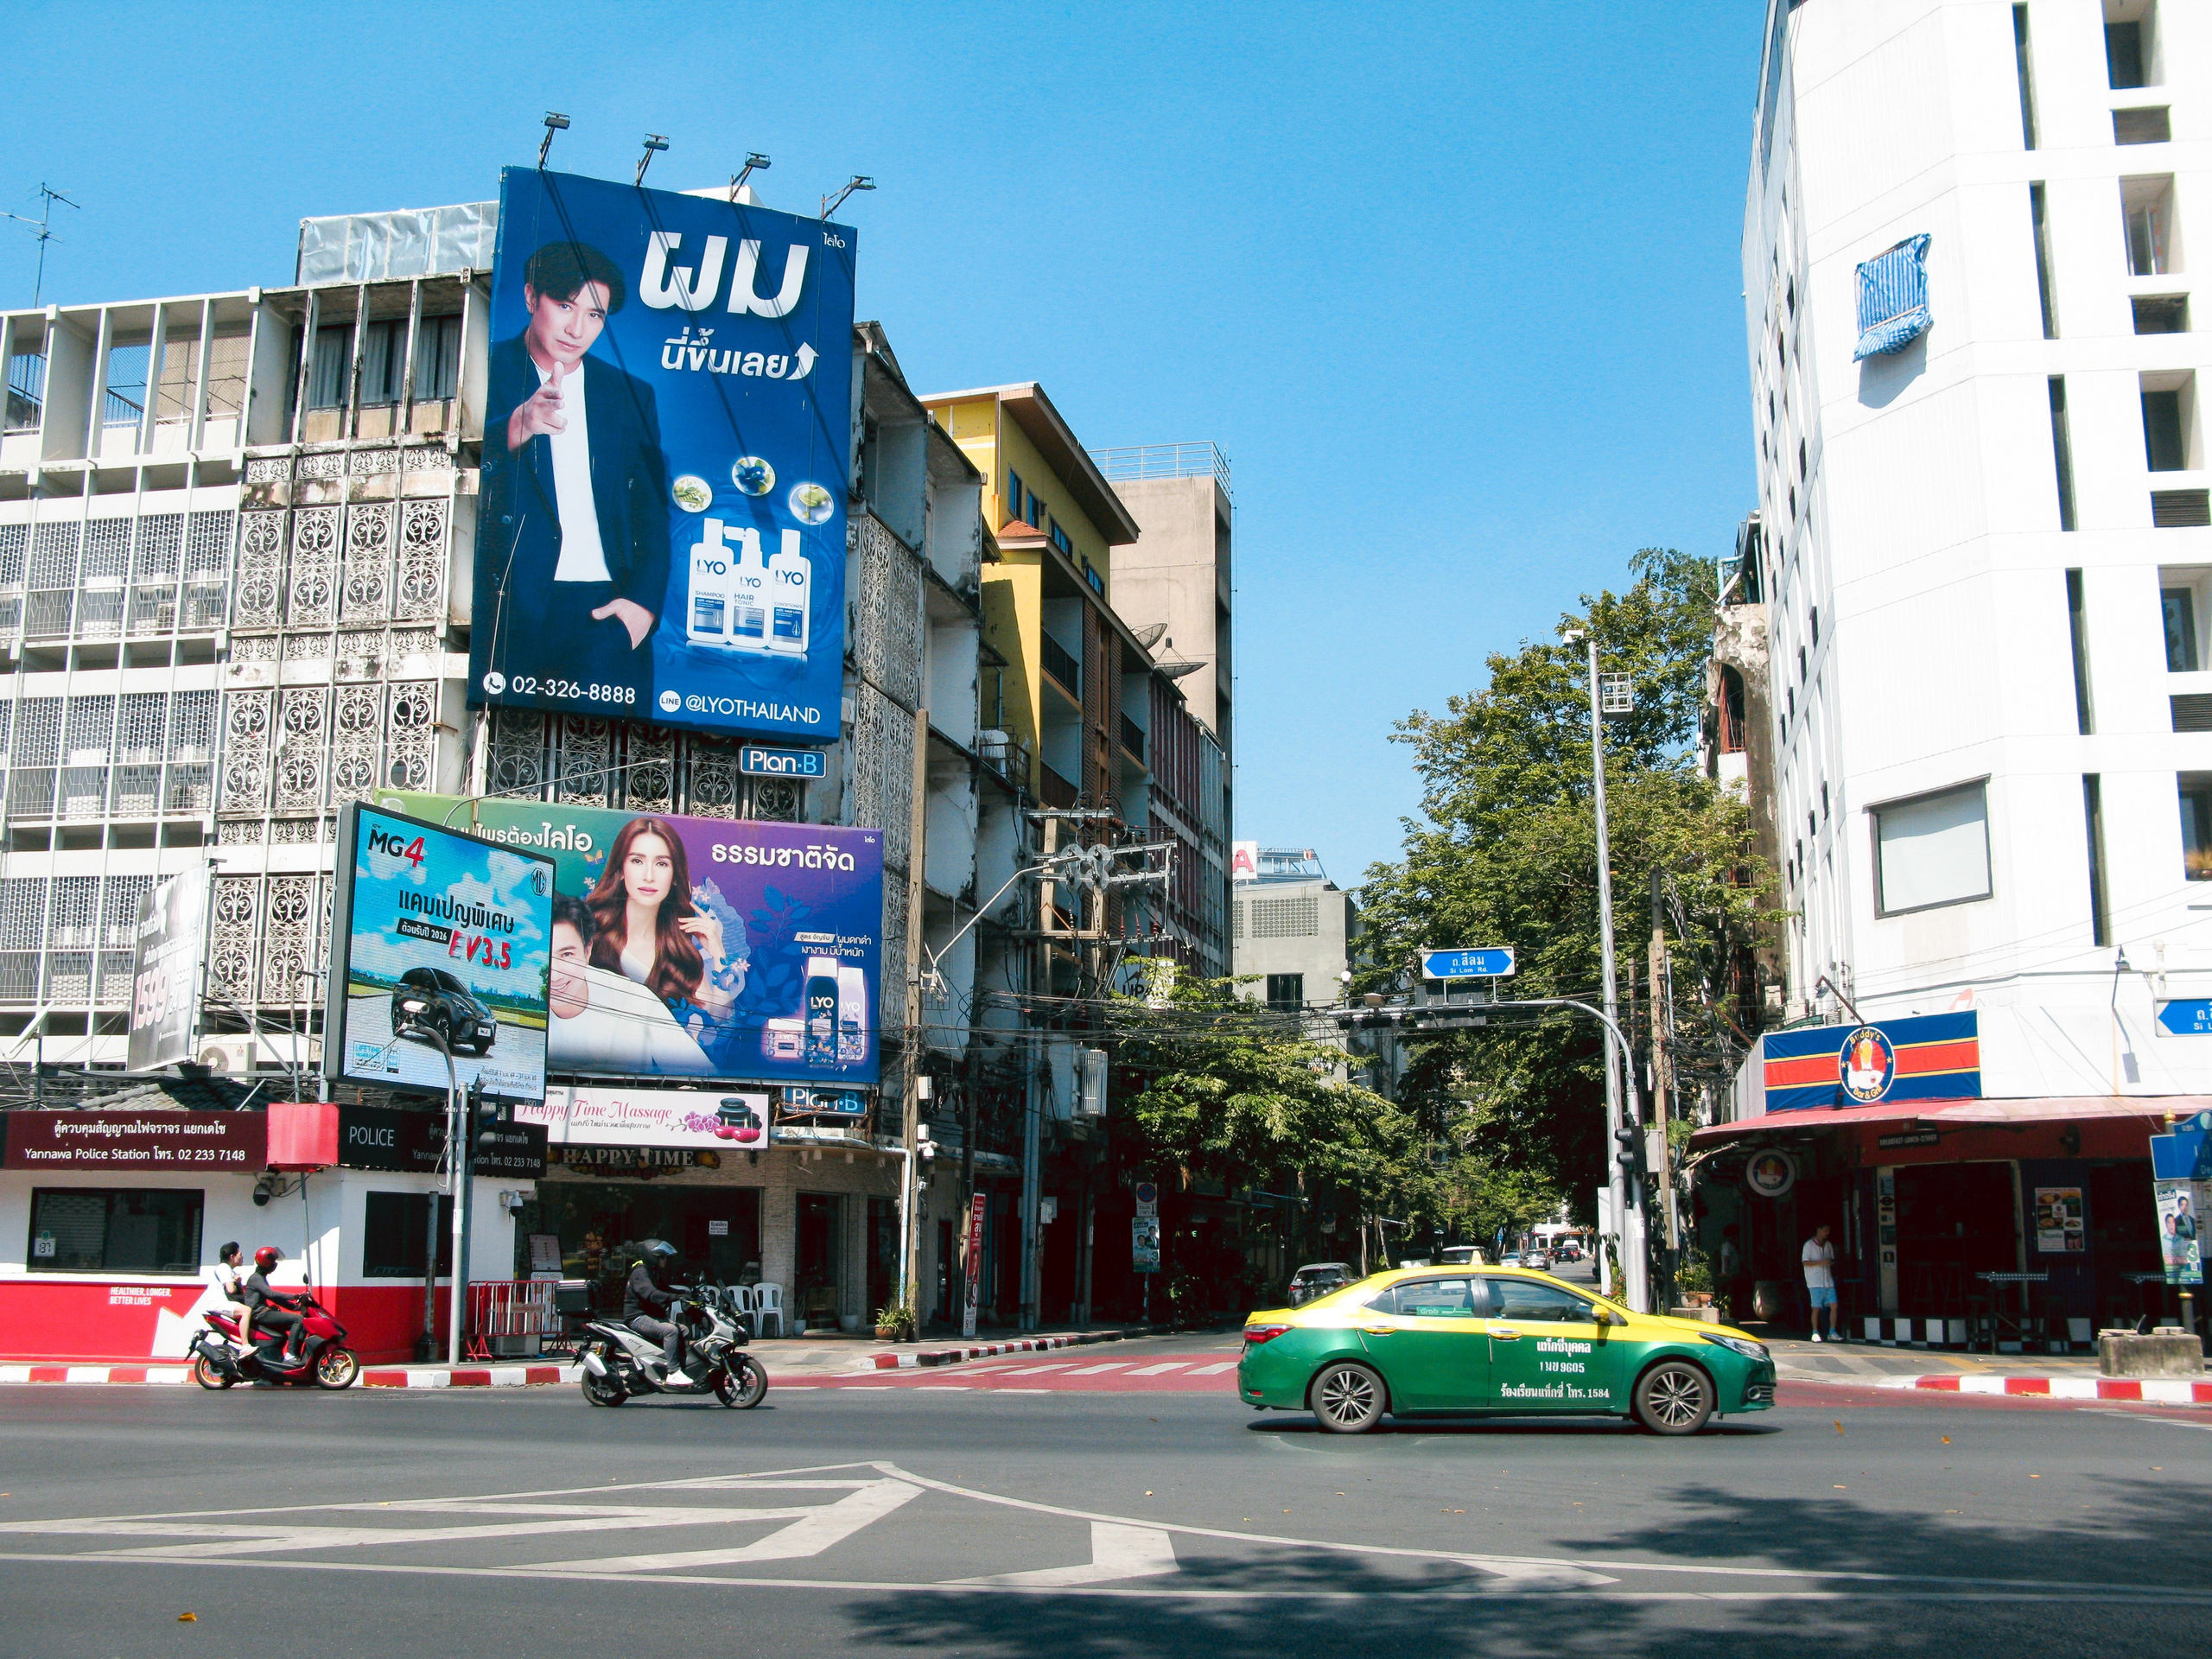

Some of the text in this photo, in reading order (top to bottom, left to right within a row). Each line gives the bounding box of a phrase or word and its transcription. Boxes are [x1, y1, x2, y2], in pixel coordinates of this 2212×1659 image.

[823, 232, 846, 248] ไลโอ
[639, 231, 810, 319] ผม
[661, 326, 790, 379] นี่ขึ้นเลย
[696, 559, 727, 575] LYO
[740, 575, 762, 588] LYO
[774, 569, 804, 586] LYO
[695, 589, 726, 599] SHAMPOO
[734, 593, 755, 601] HAIR
[512, 675, 636, 705] 02-326-8888
[661, 694, 821, 725] LINE @LYOTHAILAND
[711, 843, 855, 872] ธรรมชาติจัด
[398, 889, 515, 934] แคมเปญพิเศษ
[402, 921, 448, 941] ต้อนรับปี 2026
[448, 930, 512, 970] EV3.5
[802, 945, 828, 956] เงางาม
[133, 962, 170, 1031] 1599
[810, 996, 835, 1009] LYO
[840, 1001, 861, 1012] LYO
[2196, 1001, 2212, 1020] ถ.
[2193, 1022, 2203, 1031] Si
[1849, 1029, 1882, 1045] Buddy's
[1853, 1086, 1865, 1099] Bar
[1865, 1090, 1871, 1099] &
[573, 1099, 607, 1117] Time
[608, 1100, 672, 1124] Massage
[54, 1119, 226, 1138] ตู้ควบคุมสัญญาณไฟจราจร แยกเดโช
[349, 1126, 395, 1147] POLICE
[24, 1145, 245, 1161] Yannawa Police Station โทร. 02 233 7148
[563, 1147, 695, 1166] HAPPY TIME
[504, 1156, 512, 1166] 02
[513, 1157, 525, 1167] 233
[526, 1158, 541, 1168] 7148
[2201, 1164, 2212, 1175] De
[2187, 1243, 2199, 1262] 3
[110, 1286, 172, 1298] HEALTHIER, LONGER,
[110, 1296, 151, 1305] BETTER LIVES
[1536, 1337, 1592, 1357] แท็กซี่บุคคล
[1560, 1362, 1586, 1373] 9605
[1500, 1382, 1610, 1398] ร้องเรียนแท็กซี่ โทร. 1584
